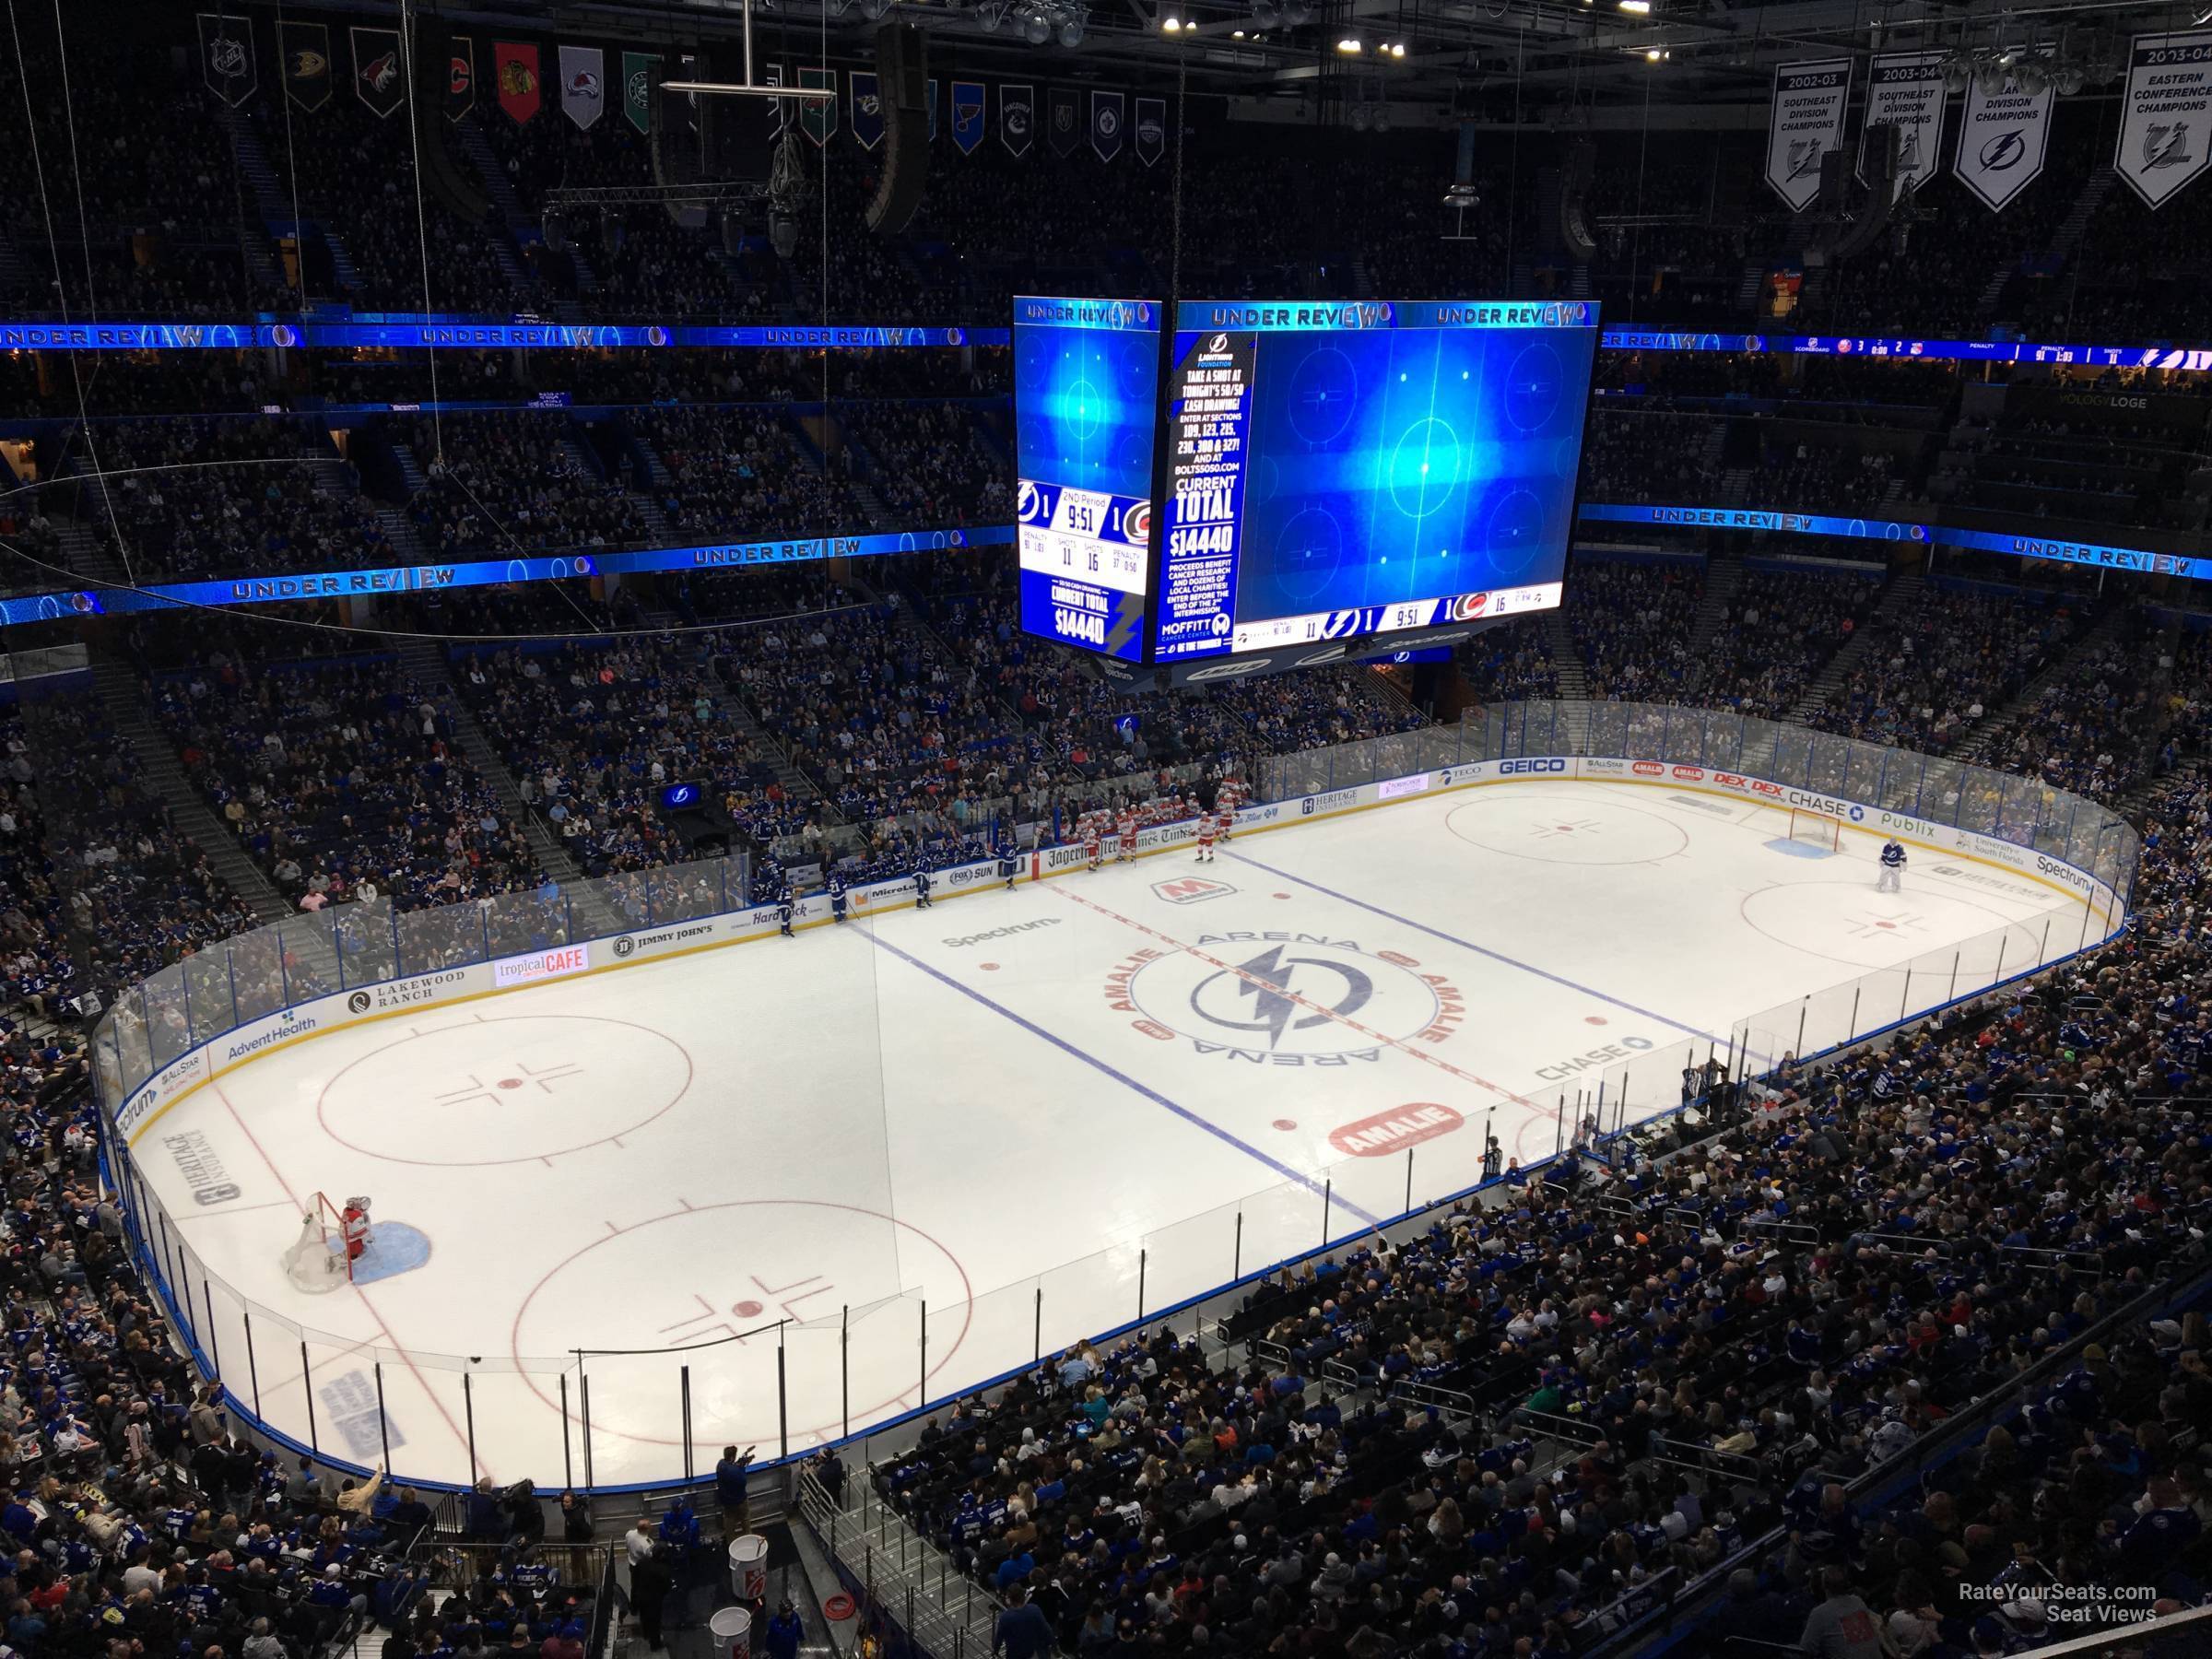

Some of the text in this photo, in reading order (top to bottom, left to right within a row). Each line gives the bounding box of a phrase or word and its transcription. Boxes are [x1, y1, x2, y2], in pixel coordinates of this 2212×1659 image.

[1788, 74, 1838, 88] 2002-03
[1882, 67, 1936, 81] 2003-04
[2147, 73, 2205, 86] EASTERN
[1877, 89, 1936, 101] SOUTHEAST
[2134, 86, 2212, 100] CONFERENCE
[1783, 95, 1838, 108] SOUTHEAST
[1883, 102, 1926, 113] DIVISION
[1984, 98, 2031, 110] DIVISION
[2136, 100, 2207, 113] CHAMPIONS
[1788, 108, 1829, 119] DIVISION
[1874, 115, 1933, 126] CHAMPIONS
[1975, 110, 2039, 122] CHAMPIONS
[1781, 120, 1835, 132] CHAMPIONS
[1027, 304, 1133, 325] UNDER REVIEW
[1211, 304, 1377, 329] UNDER REVIEW
[1437, 302, 1574, 327] UNDER REVIEW
[0, 325, 205, 347] NDER REVIW
[420, 326, 594, 347] UNDER REVIW
[766, 330, 830, 343] UNDER
[1857, 340, 1864, 351] 3
[1895, 340, 1901, 352] 2
[1198, 353, 1233, 361] LIGHTNING
[2055, 350, 2073, 362] 1:03
[1187, 369, 1241, 382] TAKE A SHOT AT
[1182, 383, 1244, 397] TONIGHT'S 50/50
[1184, 398, 1241, 412] CASH DRAWING!
[2111, 397, 2147, 408] LOGE
[1180, 413, 1241, 423] ENTER AT SECTIONS
[1194, 453, 1223, 464] AND AT
[1174, 463, 1240, 476] BOLTS5050.COM
[1176, 475, 1237, 492] CURRENT
[1063, 491, 1106, 507] 2ND Period
[1175, 488, 1234, 524] TOTAL
[1042, 494, 1120, 532] 1 9:51 1
[1653, 509, 1814, 532] UNDER REVIEW
[1170, 525, 1233, 558] $14440
[694, 537, 861, 566] UNDER REVIEW
[1063, 547, 1071, 565] 11
[2012, 539, 2191, 575] UNDER REVIEW
[1088, 552, 1099, 571] 16
[1169, 559, 1232, 572] PROCEEDS BENEFIT
[1169, 567, 1231, 580] CANCER RESEARCH
[1172, 579, 1188, 587] AND
[1189, 576, 1216, 585] DOZENS
[231, 566, 456, 600] UNDER REVIEW
[1170, 587, 1191, 595] LOCAL
[1052, 585, 1109, 613] CURRENT TOTAL
[1167, 590, 1230, 604] ENTER BEFORE THE
[1495, 597, 1505, 612] 16
[1173, 606, 1221, 618] INTERMISSION
[1397, 608, 1418, 627] 9:51
[1054, 608, 1105, 644] $14440
[1162, 618, 1212, 636] MOFFITT
[1306, 622, 1316, 638] 11
[1161, 630, 1210, 641] CANCER CENTER
[1453, 766, 1482, 778] TECO
[1500, 759, 1566, 775] GEICO
[1634, 764, 1664, 773] AMALIE
[1674, 768, 1702, 778] AMALIE
[1713, 772, 1785, 796] DEX DEX
[1315, 789, 1358, 806] HERITAGE
[1315, 799, 1358, 812] INSURANCE
[1789, 792, 1848, 817] CHASE
[1881, 812, 1936, 838] Publix
[1975, 837, 2015, 853] University
[1974, 845, 2024, 866] South Florida
[954, 866, 994, 882] FOX SUN
[2037, 855, 2090, 891] Spectrum
[752, 902, 780, 925] Hard
[637, 924, 713, 948] JIMMY JOHN'S
[942, 917, 1058, 948] Spectrum
[1197, 931, 1361, 951] ARENA
[500, 957, 546, 977] tropical
[546, 949, 583, 972] CAFE
[377, 971, 465, 997] LAKEWOOD
[1104, 947, 1165, 1012] AMALIE
[378, 989, 433, 1008] RANCH
[1416, 974, 1466, 1043] AMALIE
[228, 1018, 317, 1061] AdventHealth
[1194, 1040, 1381, 1067] ARENA
[1535, 1044, 1630, 1081] CHASE
[1342, 1105, 1456, 1152] AMALIE
[161, 1134, 215, 1189] HERITAGE
